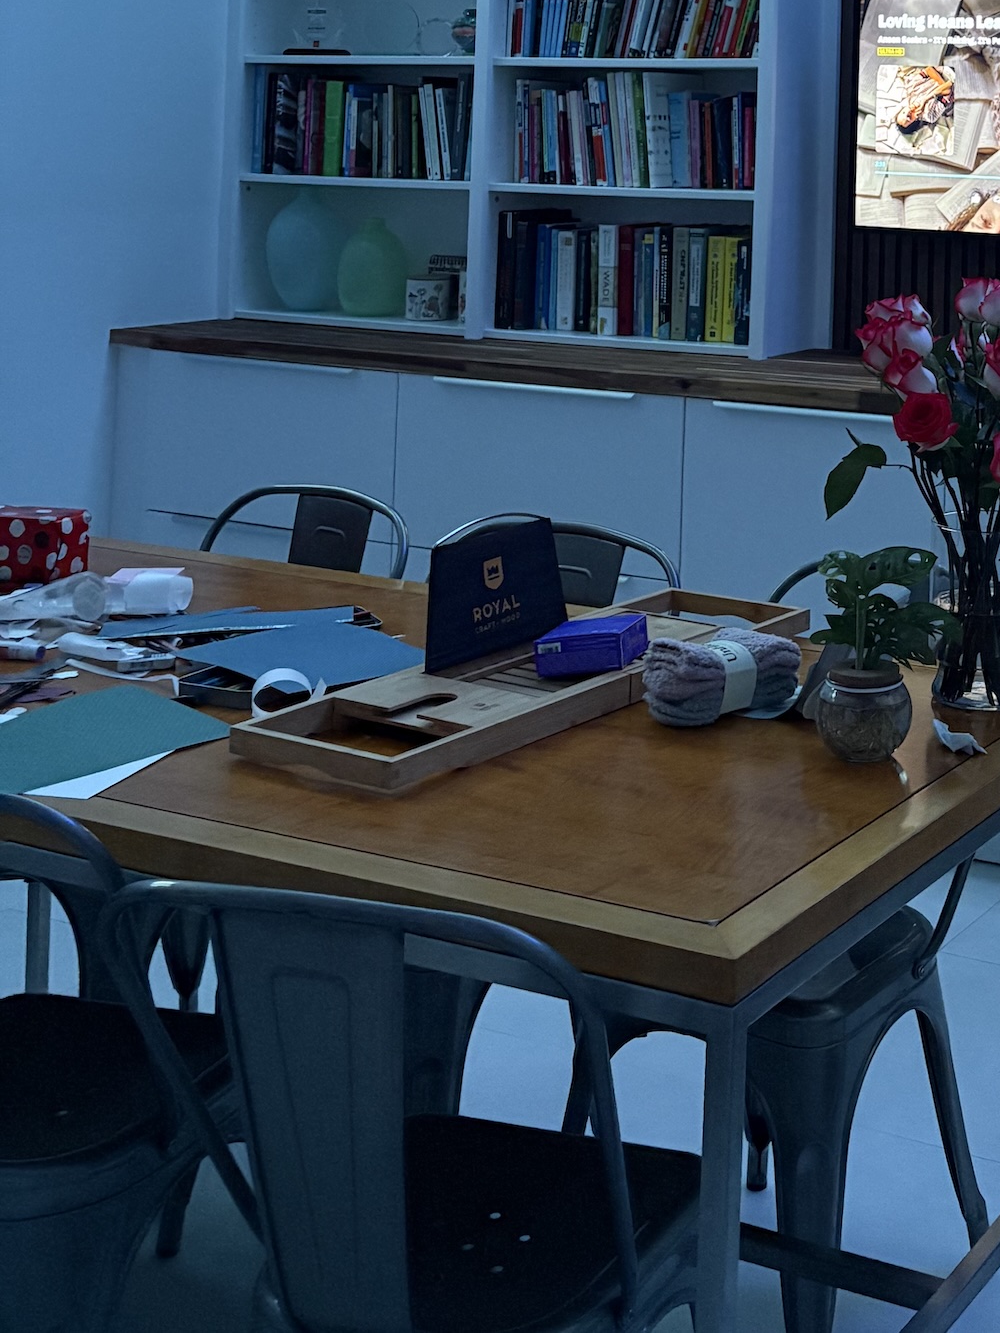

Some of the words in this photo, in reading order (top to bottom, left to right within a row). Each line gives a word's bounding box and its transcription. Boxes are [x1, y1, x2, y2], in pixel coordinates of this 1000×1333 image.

[878, 13, 926, 33] Loving
[927, 15, 975, 29] Means
[602, 271, 610, 303] WADE
[472, 594, 521, 623] ROYAL
